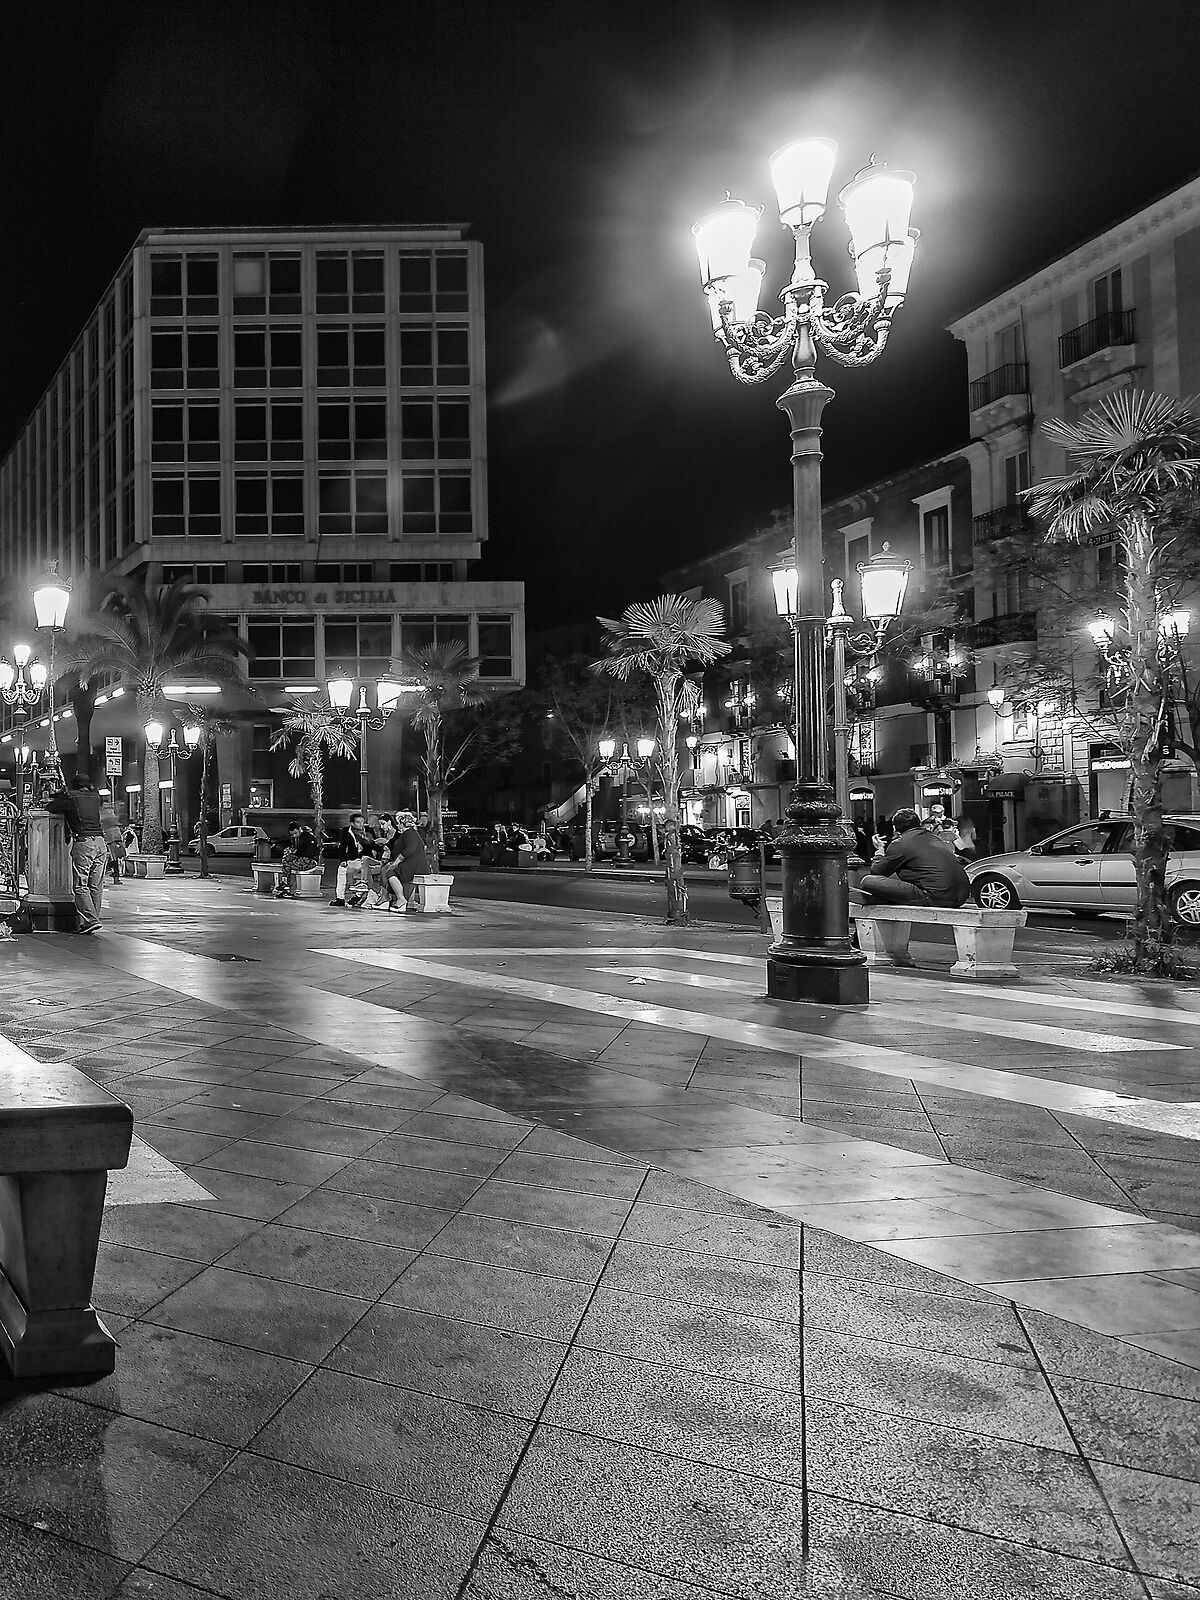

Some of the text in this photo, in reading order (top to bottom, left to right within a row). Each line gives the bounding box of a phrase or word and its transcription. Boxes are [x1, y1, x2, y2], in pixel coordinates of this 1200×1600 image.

[252, 588, 397, 604] BANCO di SICILIA
[24, 783, 30, 793] P
